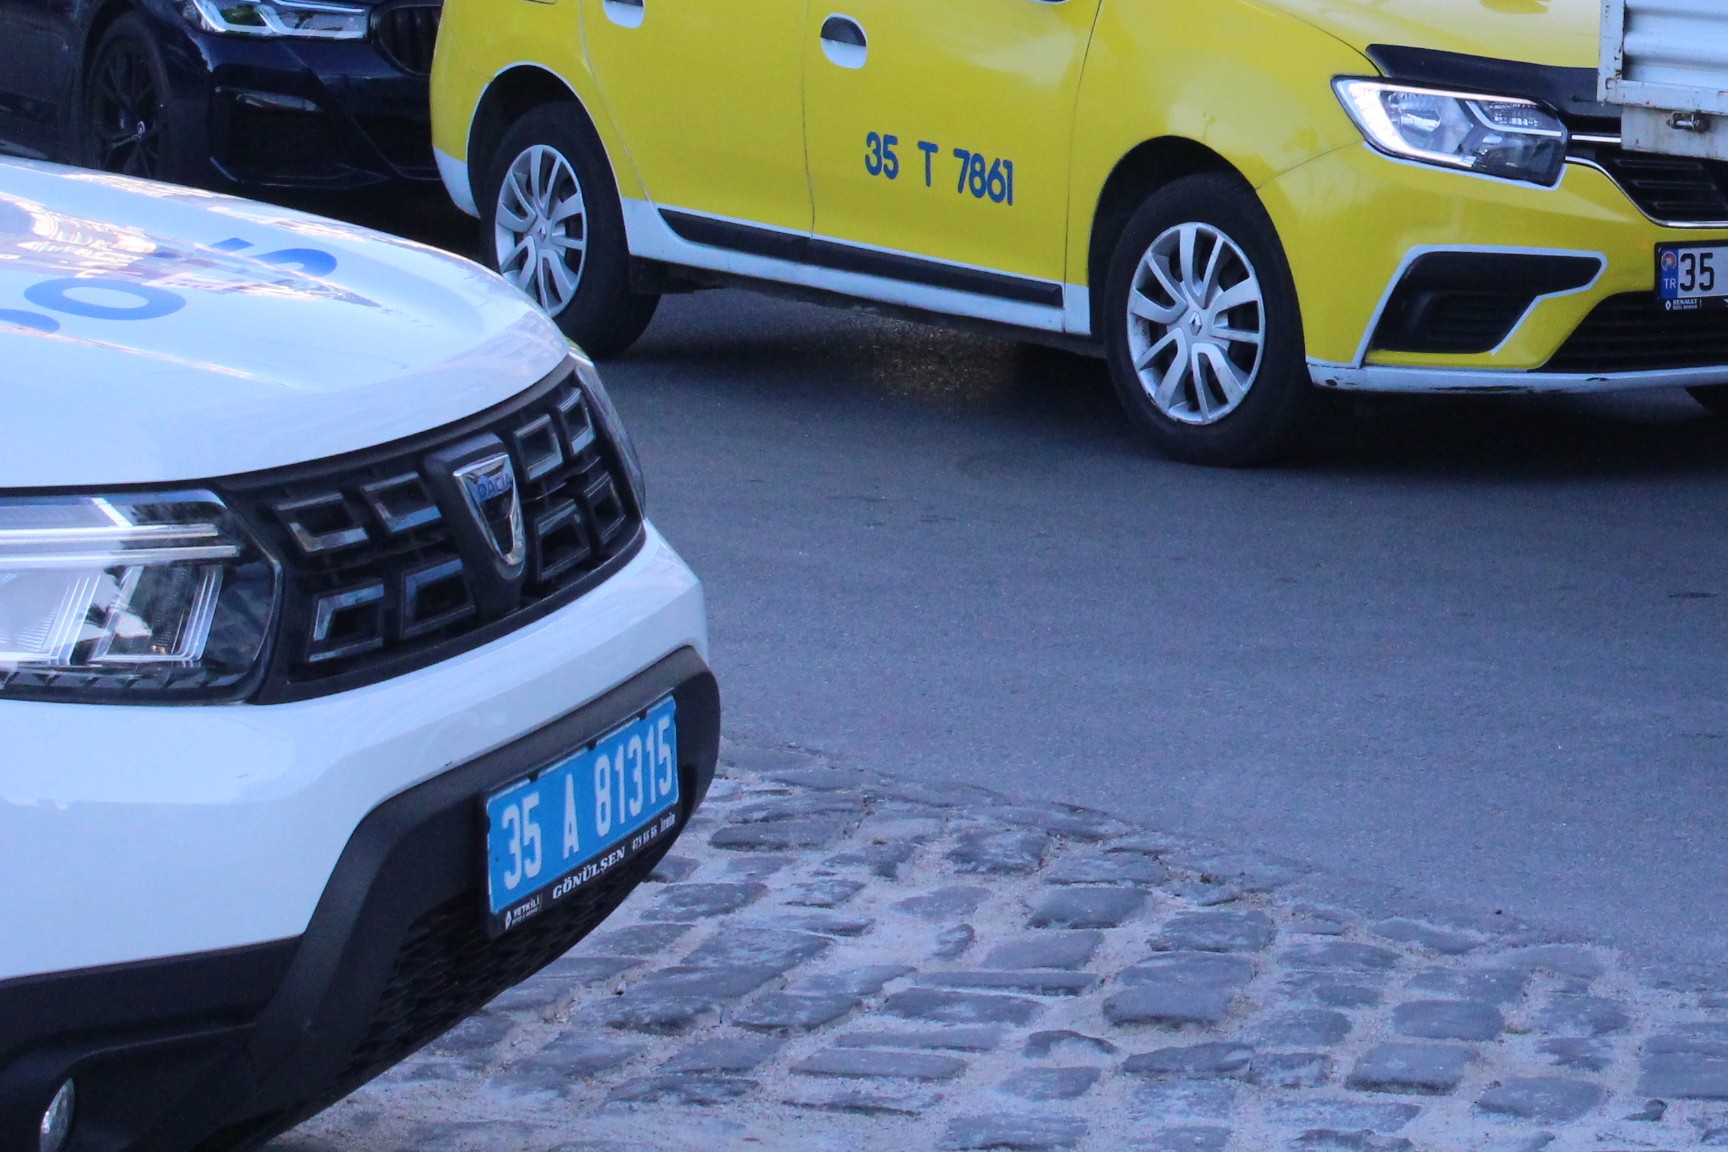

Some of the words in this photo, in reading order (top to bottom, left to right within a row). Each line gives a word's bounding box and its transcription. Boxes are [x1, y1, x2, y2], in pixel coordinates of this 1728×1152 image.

[865, 131, 899, 180] 35
[917, 140, 939, 188] T
[953, 147, 1013, 207] 7861
[1663, 278, 1676, 290] TR
[1679, 252, 1715, 292] 35
[478, 473, 513, 500] DACIA
[502, 791, 542, 890] 35
[563, 774, 580, 859] A
[594, 715, 673, 838] 81315
